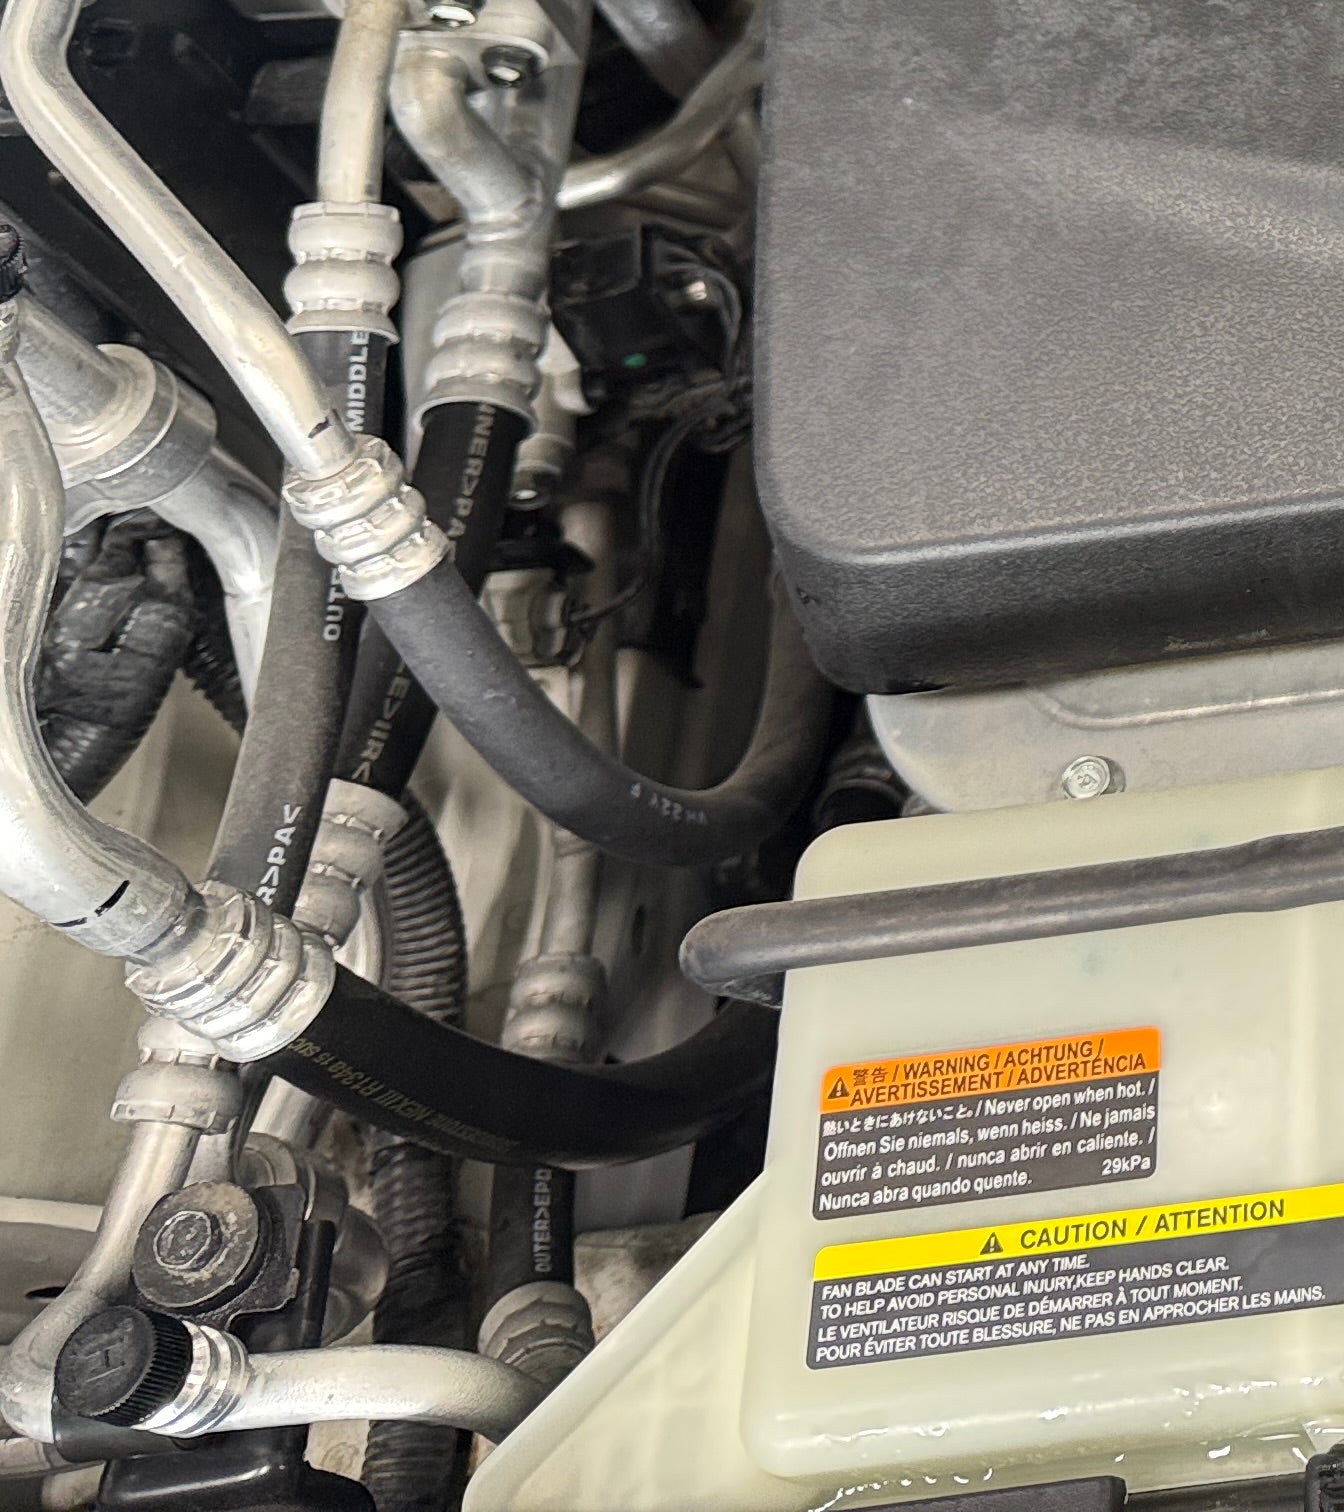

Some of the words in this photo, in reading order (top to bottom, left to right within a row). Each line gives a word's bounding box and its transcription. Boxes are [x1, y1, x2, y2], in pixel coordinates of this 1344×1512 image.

[903, 1054, 989, 1080] WARNING
[1003, 1041, 1093, 1068] ACHTUNG
[850, 1071, 1004, 1107] AVERTISSEMENT
[985, 1098, 1031, 1116] Never
[1034, 1093, 1071, 1111] open
[1074, 1086, 1113, 1104] when
[1116, 1080, 1145, 1098] hot.
[824, 1141, 875, 1161] Öffnen
[879, 1135, 904, 1153] Sie
[911, 1127, 973, 1149] niemals,
[977, 1124, 1018, 1141] wenn
[1022, 1116, 1066, 1135] heiss.
[1081, 1110, 1102, 1127] Ne
[1104, 1103, 1155, 1129] jamais
[821, 1164, 866, 1186] ouvrir
[887, 1155, 940, 1177] chaud.
[957, 1150, 1005, 1168] nunca
[1010, 1142, 1048, 1162] abrir
[1052, 1141, 1071, 1156] en
[1077, 1130, 1143, 1153] caliente.
[1102, 1155, 1150, 1175] 29kPa
[819, 1192, 869, 1211] Nunca
[872, 1186, 908, 1204] abra
[912, 1177, 970, 1202] quando
[974, 1171, 1032, 1194] quente.
[1020, 1218, 1124, 1249] CAUTION
[1154, 1199, 1284, 1233] ATTENTION
[820, 1304, 841, 1319] TO
[844, 1298, 884, 1317] HELP
[886, 1292, 934, 1312] AVOID
[937, 1282, 1019, 1305] PERSONAL
[1118, 1263, 1172, 1283] HANDS
[1176, 1257, 1229, 1276] CLEAR.
[822, 1283, 852, 1300] FAN
[855, 1276, 906, 1296] BLADE
[908, 1272, 941, 1289] CAN
[945, 1266, 993, 1285] START
[995, 1263, 1014, 1279] AT
[1016, 1259, 1048, 1276] ANY
[1052, 1254, 1090, 1272] TIME.
[816, 1343, 860, 1362] POUR
[864, 1336, 916, 1356] ÉVITER
[919, 1329, 969, 1349] TOUTE
[972, 1319, 1056, 1343] BLESSURE,
[1060, 1315, 1082, 1332] NE
[1085, 1311, 1115, 1329] PAS
[1118, 1308, 1139, 1325] EN
[1142, 1296, 1239, 1322] APPROCHER
[1242, 1292, 1271, 1309] LES
[1274, 1286, 1325, 1305] MAINS.
[818, 1326, 836, 1342] LE
[840, 1314, 939, 1339] VENTILATEUR
[942, 1306, 994, 1327] RISQUE
[996, 1303, 1023, 1320] DE
[1028, 1292, 1113, 1316] DÉMARRER
[1115, 1286, 1127, 1305] À
[1130, 1285, 1168, 1303] TOUT
[1170, 1276, 1243, 1298] MOMENT.
